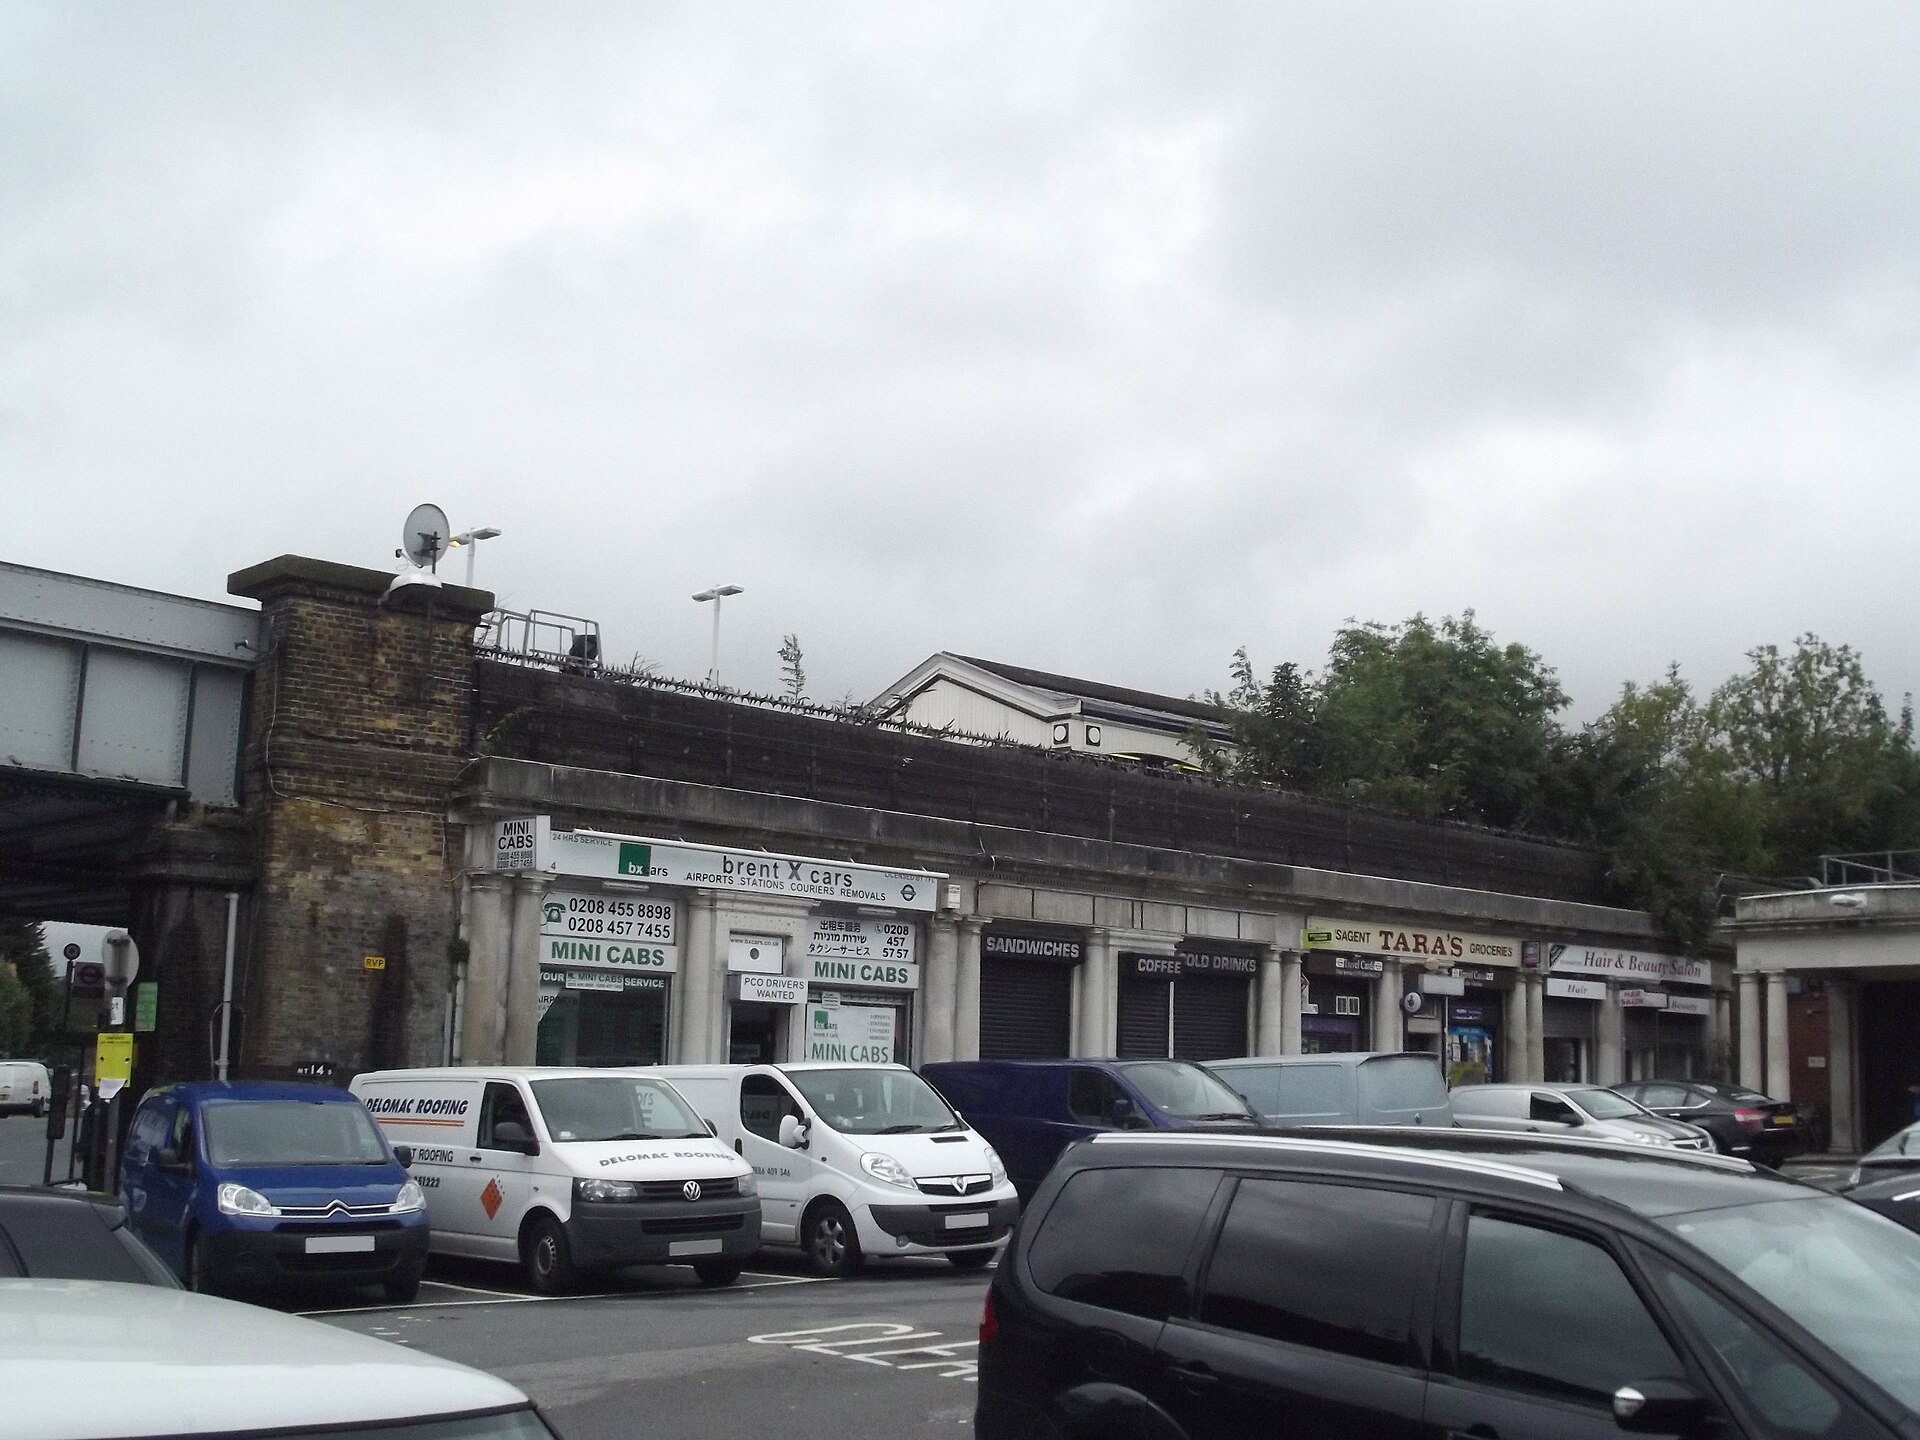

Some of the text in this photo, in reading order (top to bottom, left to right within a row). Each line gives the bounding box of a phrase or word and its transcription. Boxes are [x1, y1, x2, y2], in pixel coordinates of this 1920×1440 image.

[503, 821, 529, 835] MINI
[498, 835, 533, 850] CABS
[562, 834, 578, 843] HRS
[580, 836, 613, 846] SERVICE
[723, 855, 853, 887] brent X cars
[569, 897, 671, 920] 0208 455 8898
[568, 917, 670, 939] 0208 457 7455
[884, 924, 909, 936] 0208
[886, 936, 905, 947] 457
[986, 936, 1080, 959] SANDWICHES
[1379, 930, 1463, 958] TARA'S
[551, 941, 665, 967] MINI CABS
[808, 943, 871, 956] タクシーサービス
[1470, 943, 1513, 958] GROCERIES
[366, 958, 384, 967] RVP
[1137, 958, 1181, 975] COFFEE
[1213, 955, 1257, 973] DRINKS
[1584, 951, 1702, 978] Hair & Beauty Salon
[578, 973, 622, 983] MINI CABS
[814, 961, 908, 984] MINI CABS
[624, 976, 665, 988] SERVICE
[744, 977, 805, 990] PCO DRIVERS
[1567, 984, 1587, 995] Hair
[756, 989, 795, 1000] WANTED
[812, 1042, 889, 1064] MINI CABS
[366, 1098, 469, 1116] DELOMAC ROOFING
[419, 1148, 454, 1162] ROOFING
[599, 1151, 735, 1167] DELOMAC ROOFING
